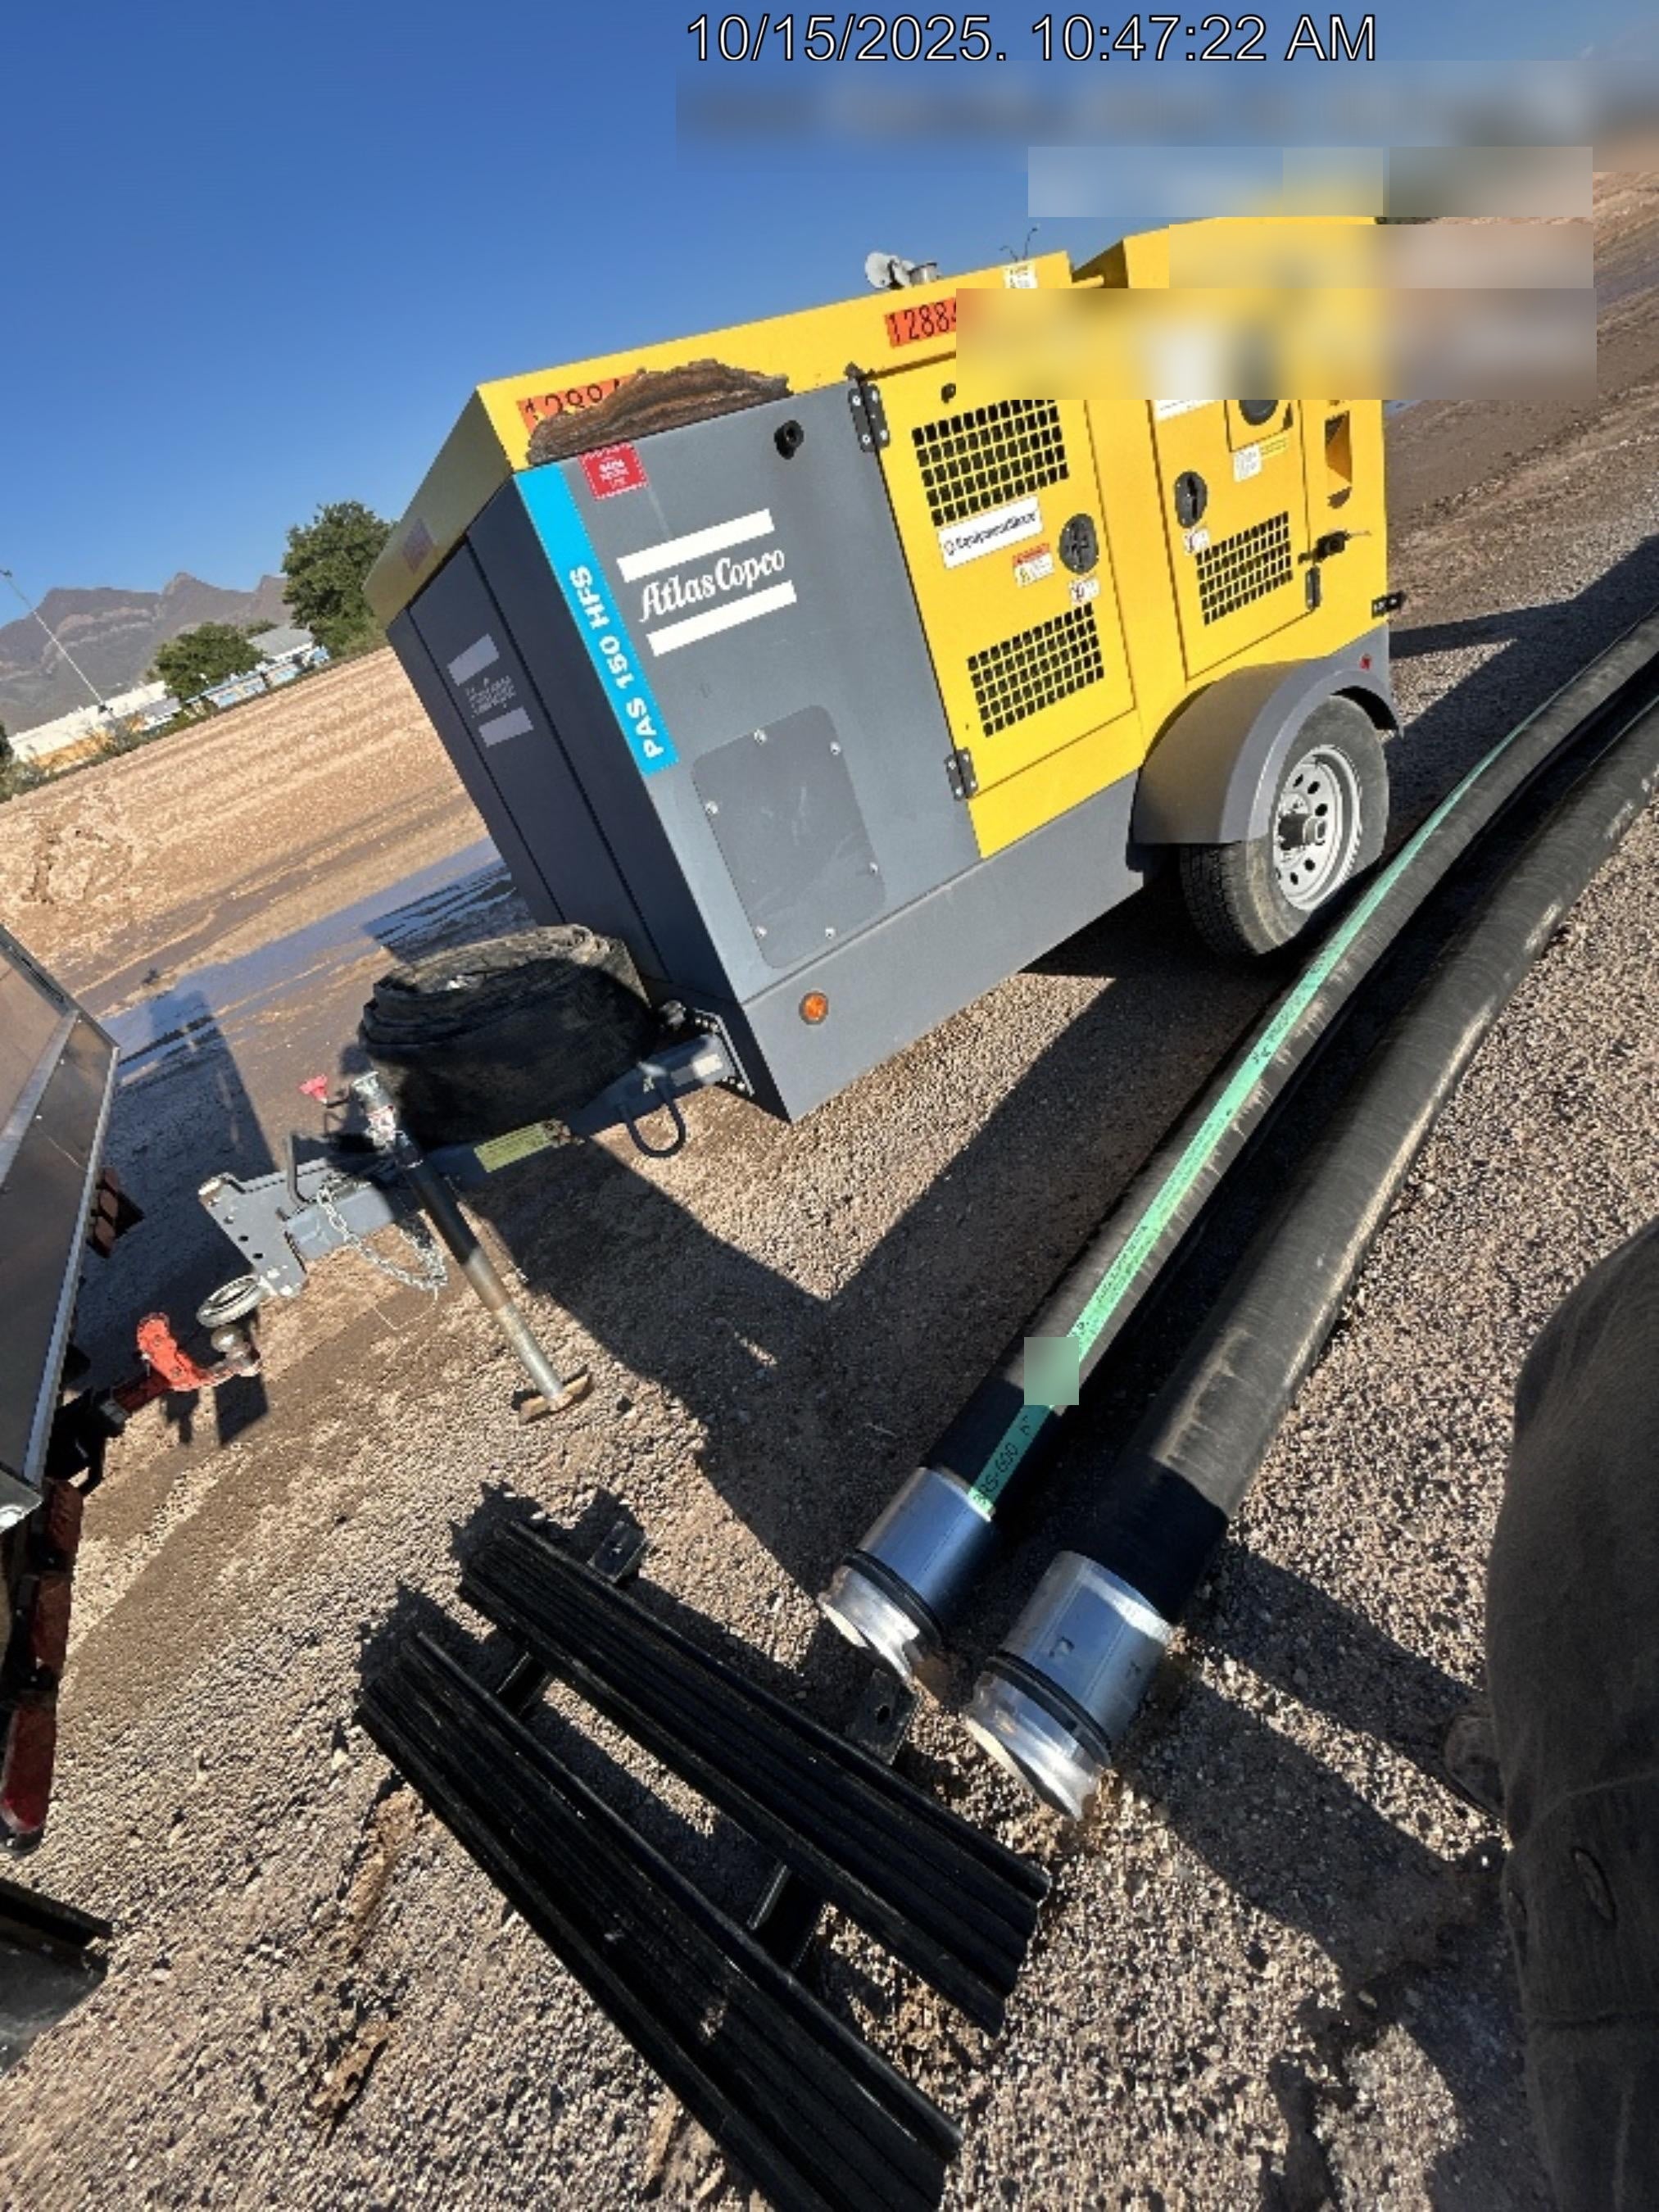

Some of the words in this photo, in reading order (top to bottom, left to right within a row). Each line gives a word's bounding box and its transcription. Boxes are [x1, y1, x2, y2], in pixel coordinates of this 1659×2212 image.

[890, 301, 956, 343] 1288
[569, 565, 610, 629] HFS
[639, 575, 716, 623] Atlas
[715, 549, 786, 590] Copco
[599, 636, 635, 689] 150
[625, 697, 664, 759] PAS
